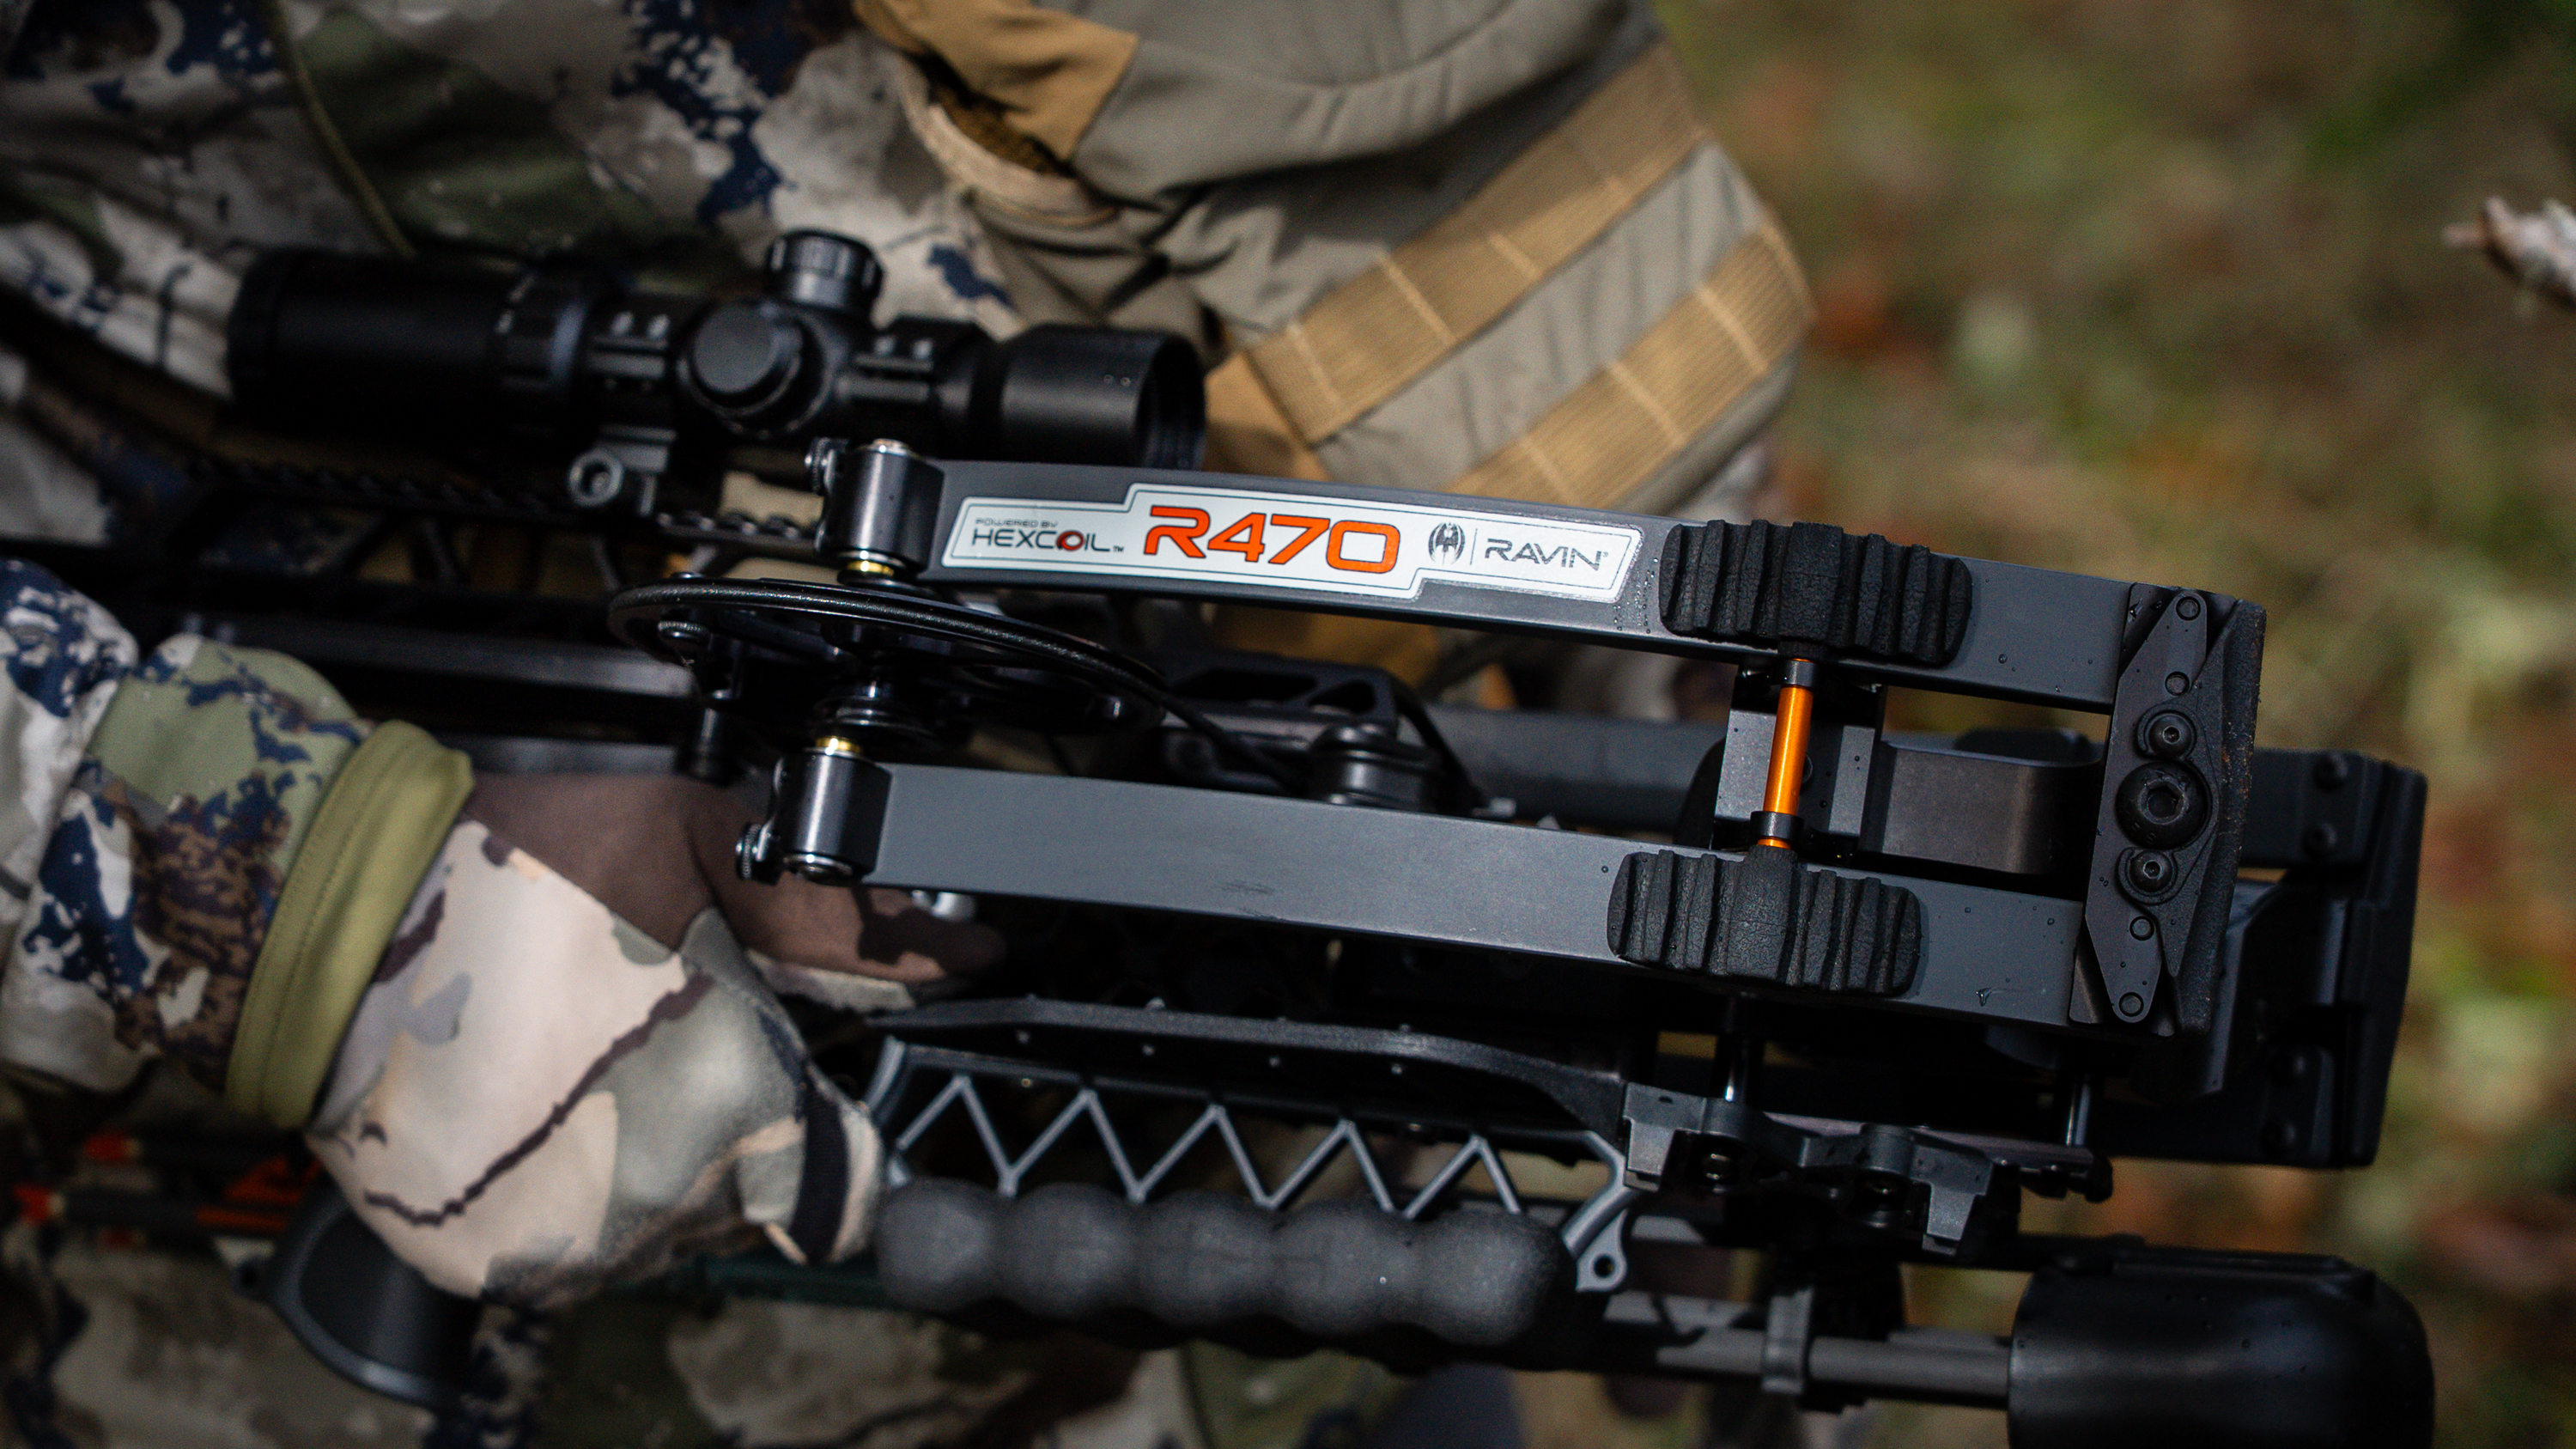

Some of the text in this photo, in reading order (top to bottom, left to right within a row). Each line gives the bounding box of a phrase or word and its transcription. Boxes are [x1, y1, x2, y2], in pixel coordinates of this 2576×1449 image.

[975, 517, 1059, 528] POWERED BY
[1143, 504, 1401, 575] R470
